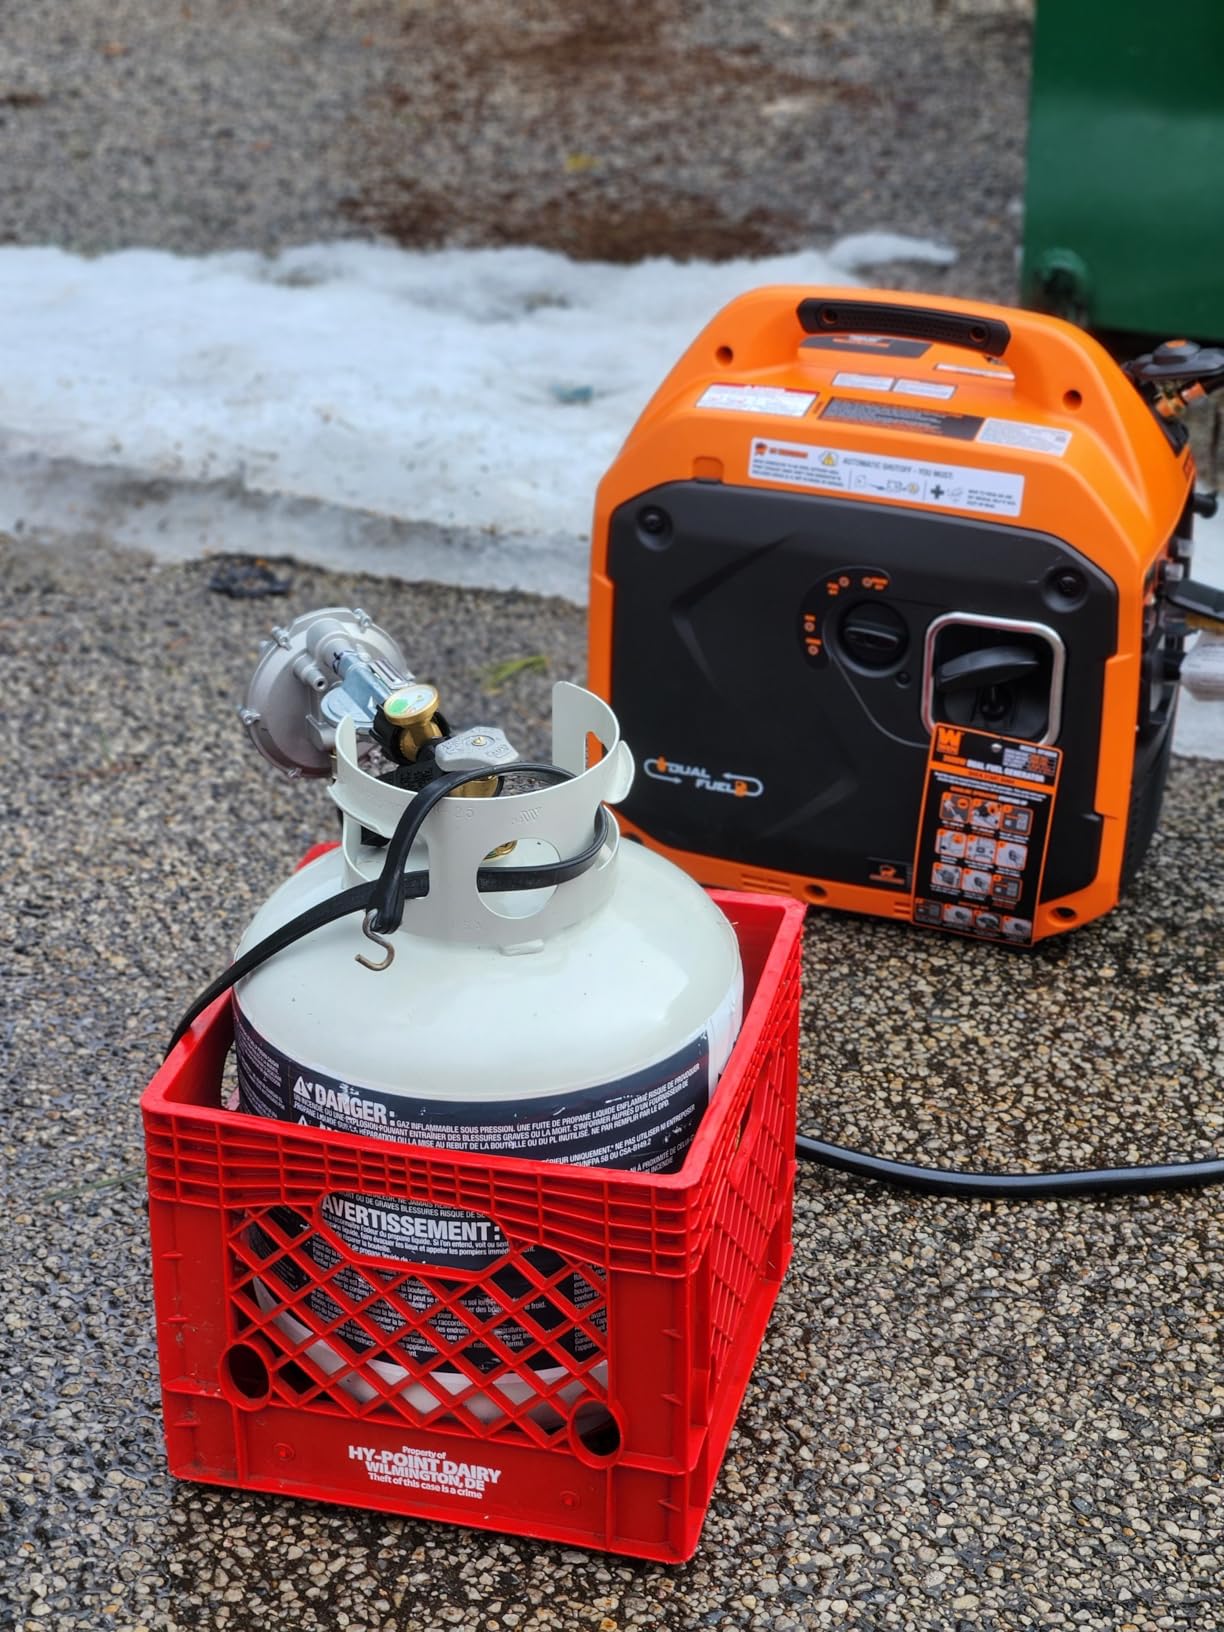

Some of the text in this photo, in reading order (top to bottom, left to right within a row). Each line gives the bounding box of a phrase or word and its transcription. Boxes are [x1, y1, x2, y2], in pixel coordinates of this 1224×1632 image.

[668, 762, 711, 779] DUAL
[695, 778, 733, 793] FUEL
[301, 1095, 324, 1112] INCENDIE
[325, 1106, 332, 1116] OU
[410, 1130, 446, 1141] ENTRAÎNER
[462, 1134, 501, 1142] BLESSURES
[502, 1131, 530, 1141] GRAVES
[542, 1128, 552, 1137] LA
[552, 1126, 572, 1136] MORT.
[572, 1116, 612, 1132] S'INFORMER
[611, 1106, 634, 1122] AUPRÈS
[634, 1102, 648, 1112] D'UN
[648, 1085, 682, 1106] FOURNISSEUR
[396, 1120, 410, 1130] GAZ
[411, 1122, 459, 1134] INFLAMMABLE
[460, 1126, 479, 1134] SOUS
[480, 1124, 516, 1134] PRESSION.
[517, 1123, 531, 1132] UNE
[532, 1120, 550, 1130] FUITE
[552, 1119, 561, 1127] DE
[562, 1112, 592, 1126] PROPANE
[592, 1106, 616, 1120] LIQUIDE
[648, 1086, 666, 1100] RISQUE
[398, 1136, 406, 1144] OU
[408, 1138, 417, 1146] LA
[418, 1140, 434, 1148] MISE
[446, 1142, 468, 1150] REBUT
[470, 1142, 478, 1150] DE
[480, 1142, 490, 1150] LA
[490, 1140, 526, 1150] BOUTEILLE
[538, 1136, 548, 1145] DU
[549, 1135, 556, 1144] PL
[592, 1126, 600, 1134] NE
[614, 1114, 639, 1130] REMPLIR
[640, 1110, 651, 1118] PAR
[614, 1142, 624, 1150] NE
[624, 1138, 636, 1148] PAS
[636, 1124, 660, 1142] UTILISER
[666, 1104, 696, 1128] ENTREPOSER
[600, 1154, 608, 1162] 58
[610, 1150, 618, 1160] OU
[366, 1197, 374, 1205] DE
[374, 1200, 400, 1211] GRAVES
[400, 1204, 439, 1217] BLESSURES
[440, 1210, 464, 1218] RISQUE
[380, 1230, 386, 1238] du
[388, 1233, 410, 1244] propane
[433, 1238, 439, 1246] Si
[440, 1239, 450, 1247] l'on
[452, 1241, 474, 1249] entend,
[395, 1240, 404, 1248] les
[404, 1242, 418, 1250] lieux
[426, 1246, 448, 1254] appeler
[459, 1248, 487, 1256] pompiers
[412, 1294, 426, 1302] peut
[402, 1446, 446, 1460] Property of
[348, 1446, 502, 1484] HY-POINT DAIRY
[365, 1461, 486, 1491] WILMINGTON, DE
[368, 1472, 392, 1484] Theft
[392, 1476, 403, 1485] of
[403, 1478, 420, 1489] this
[421, 1483, 440, 1492] case
[442, 1484, 449, 1493] is
[456, 1488, 483, 1500] crime
